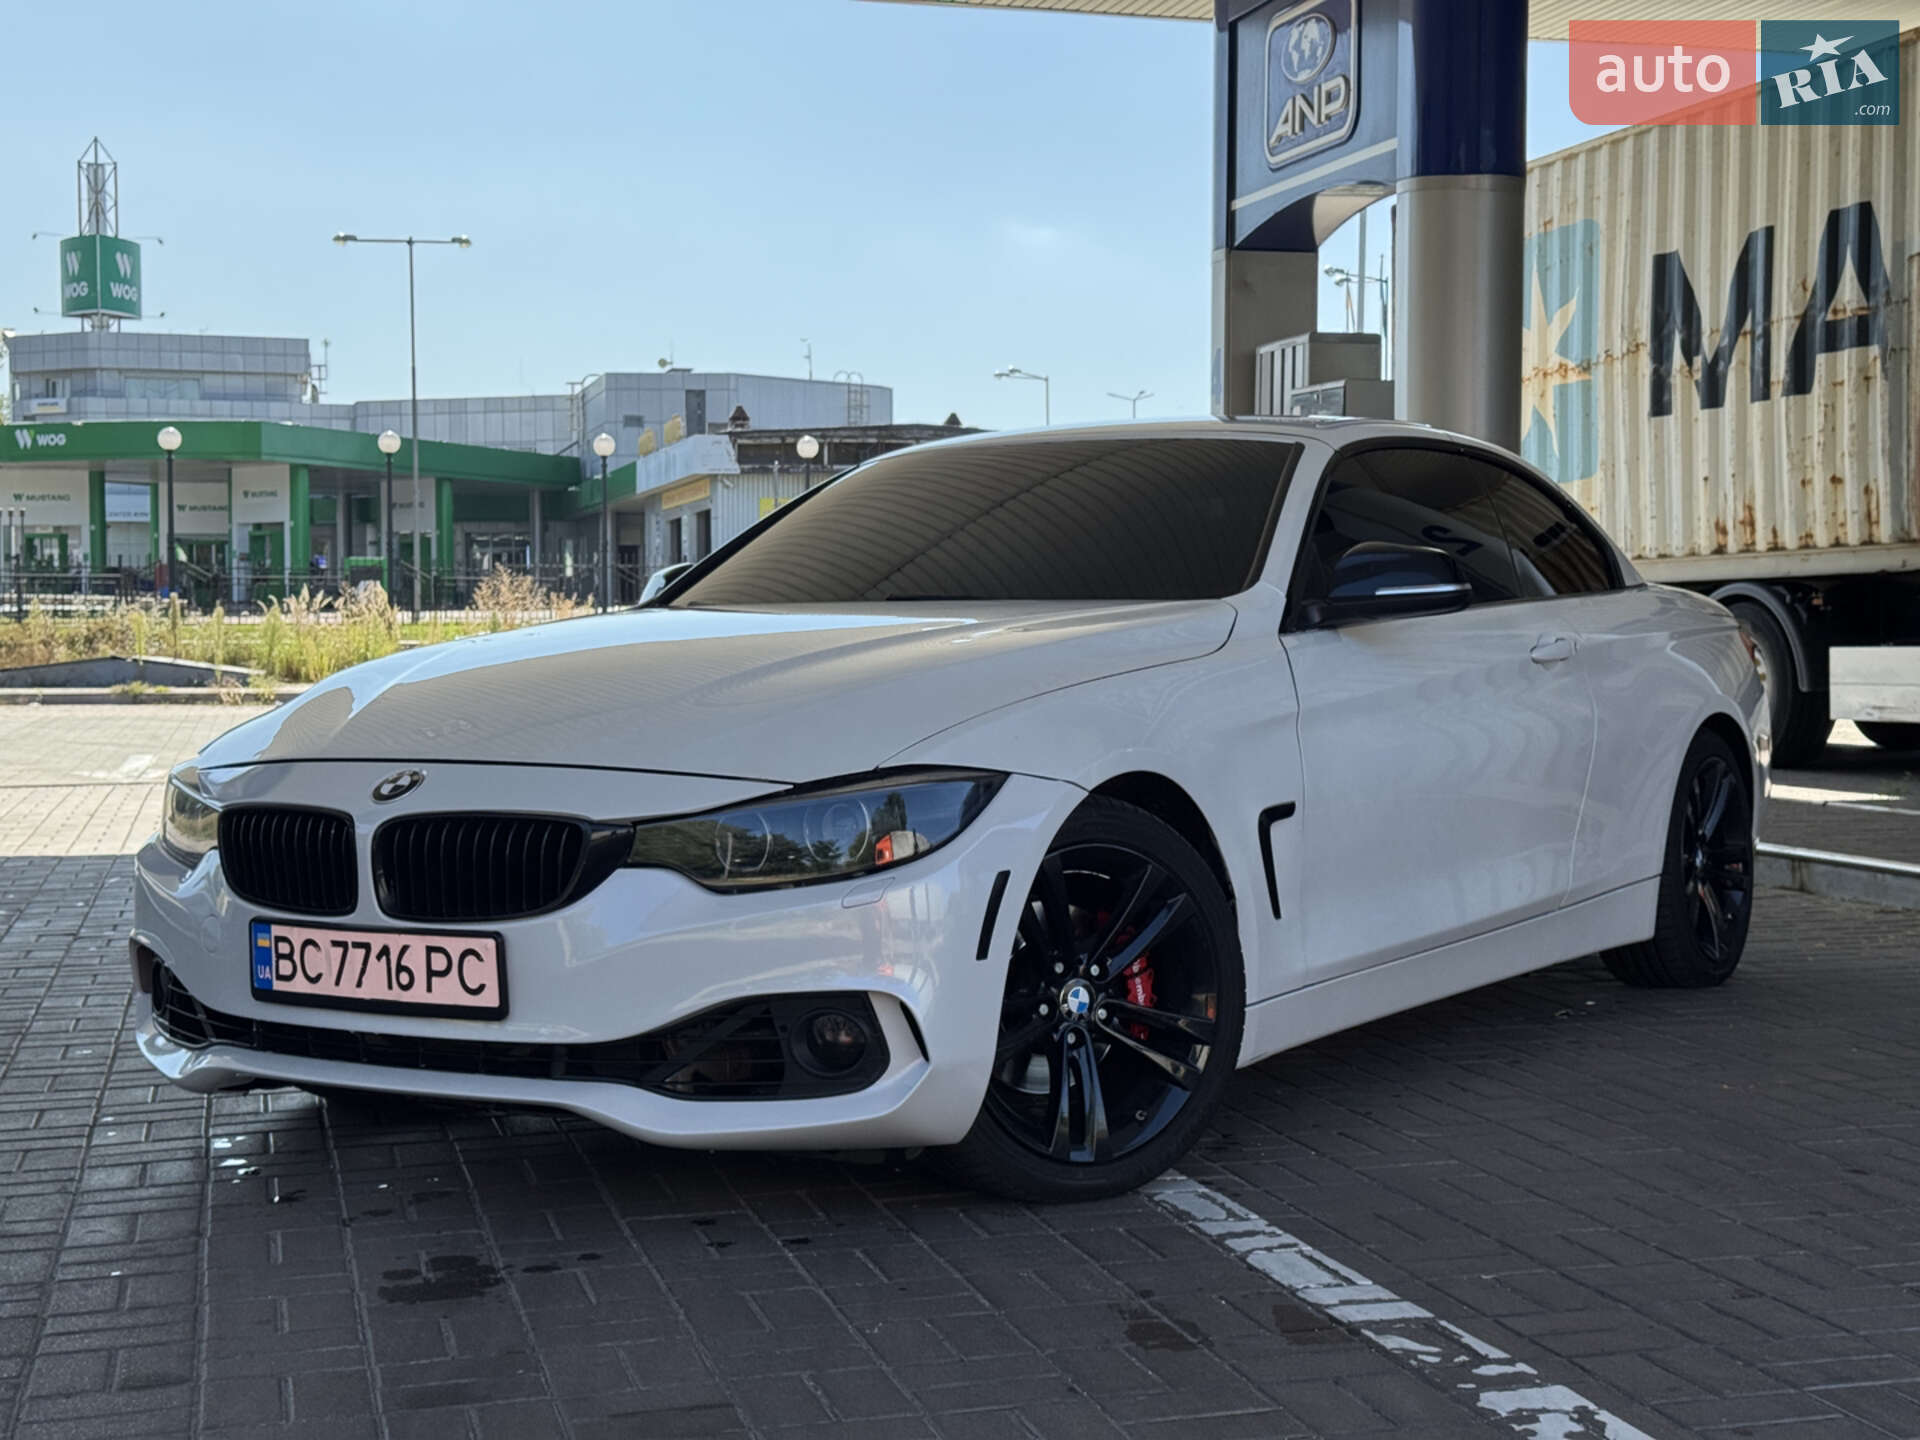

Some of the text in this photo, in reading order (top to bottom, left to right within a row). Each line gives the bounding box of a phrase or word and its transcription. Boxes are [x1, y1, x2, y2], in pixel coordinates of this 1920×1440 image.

[1269, 75, 1349, 149] ANP
[110, 281, 138, 302] WOG
[36, 433, 66, 446] WOG
[26, 494, 71, 502] MUSTANG
[258, 964, 271, 979] UA
